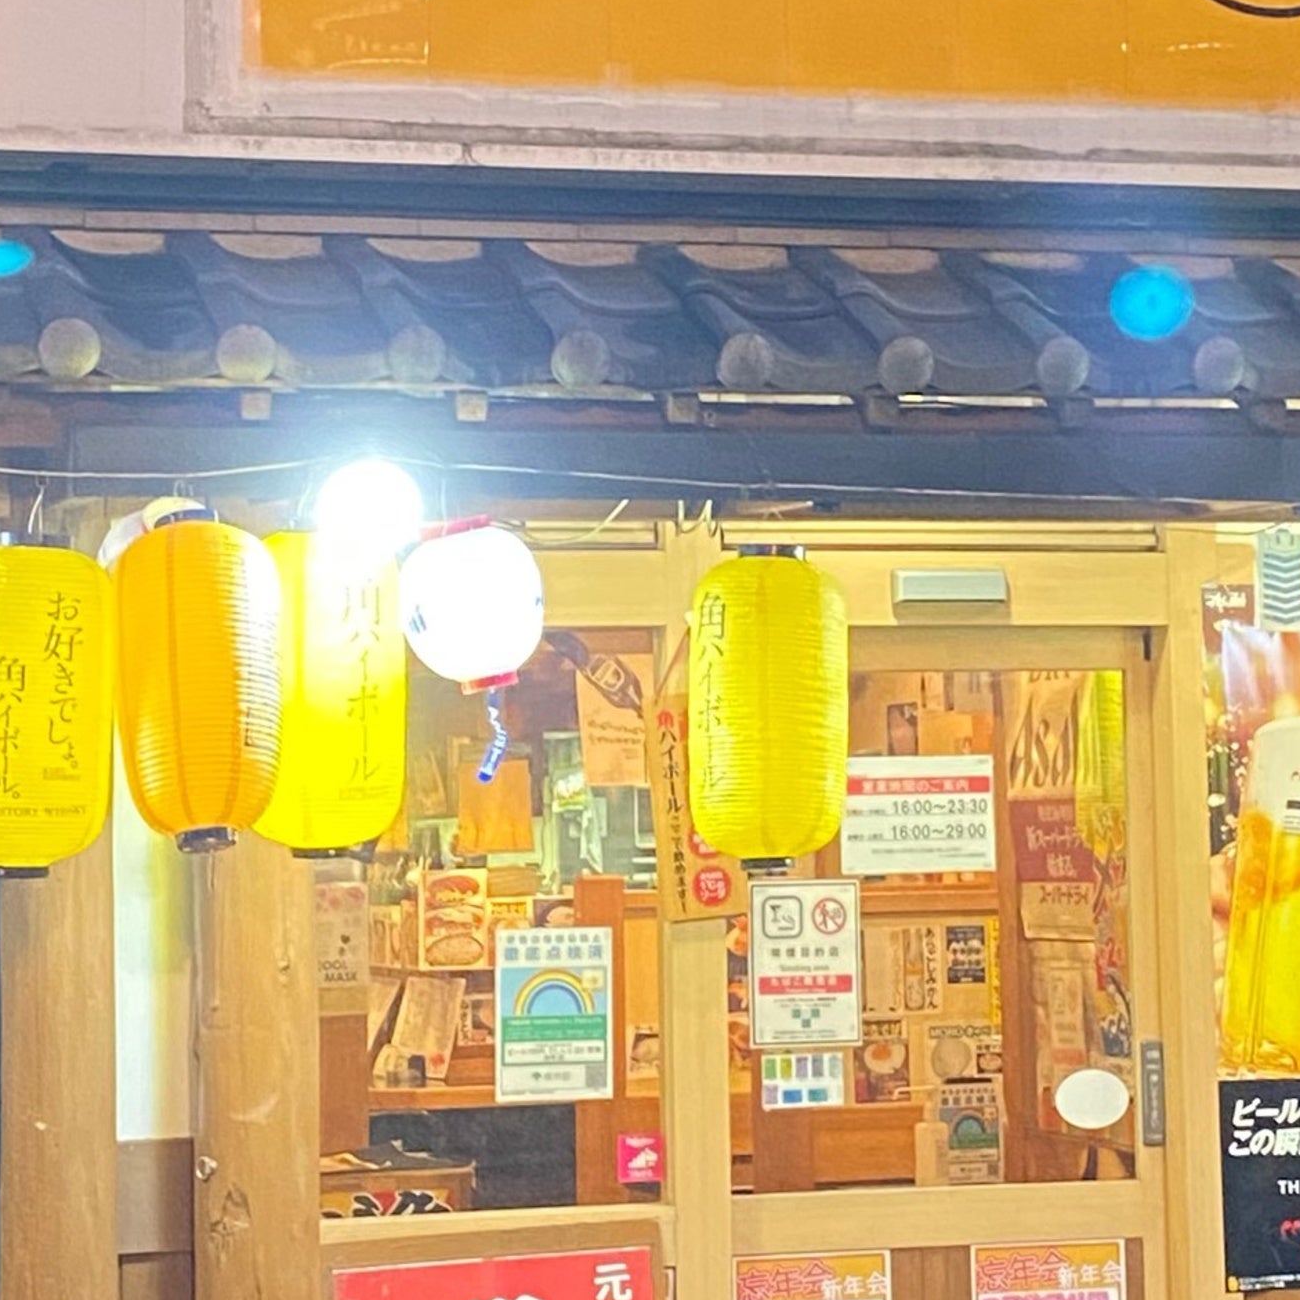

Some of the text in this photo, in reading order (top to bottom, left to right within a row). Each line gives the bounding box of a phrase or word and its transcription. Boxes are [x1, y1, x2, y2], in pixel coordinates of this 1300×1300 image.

[43, 591, 82, 771] お好きでしょ。
